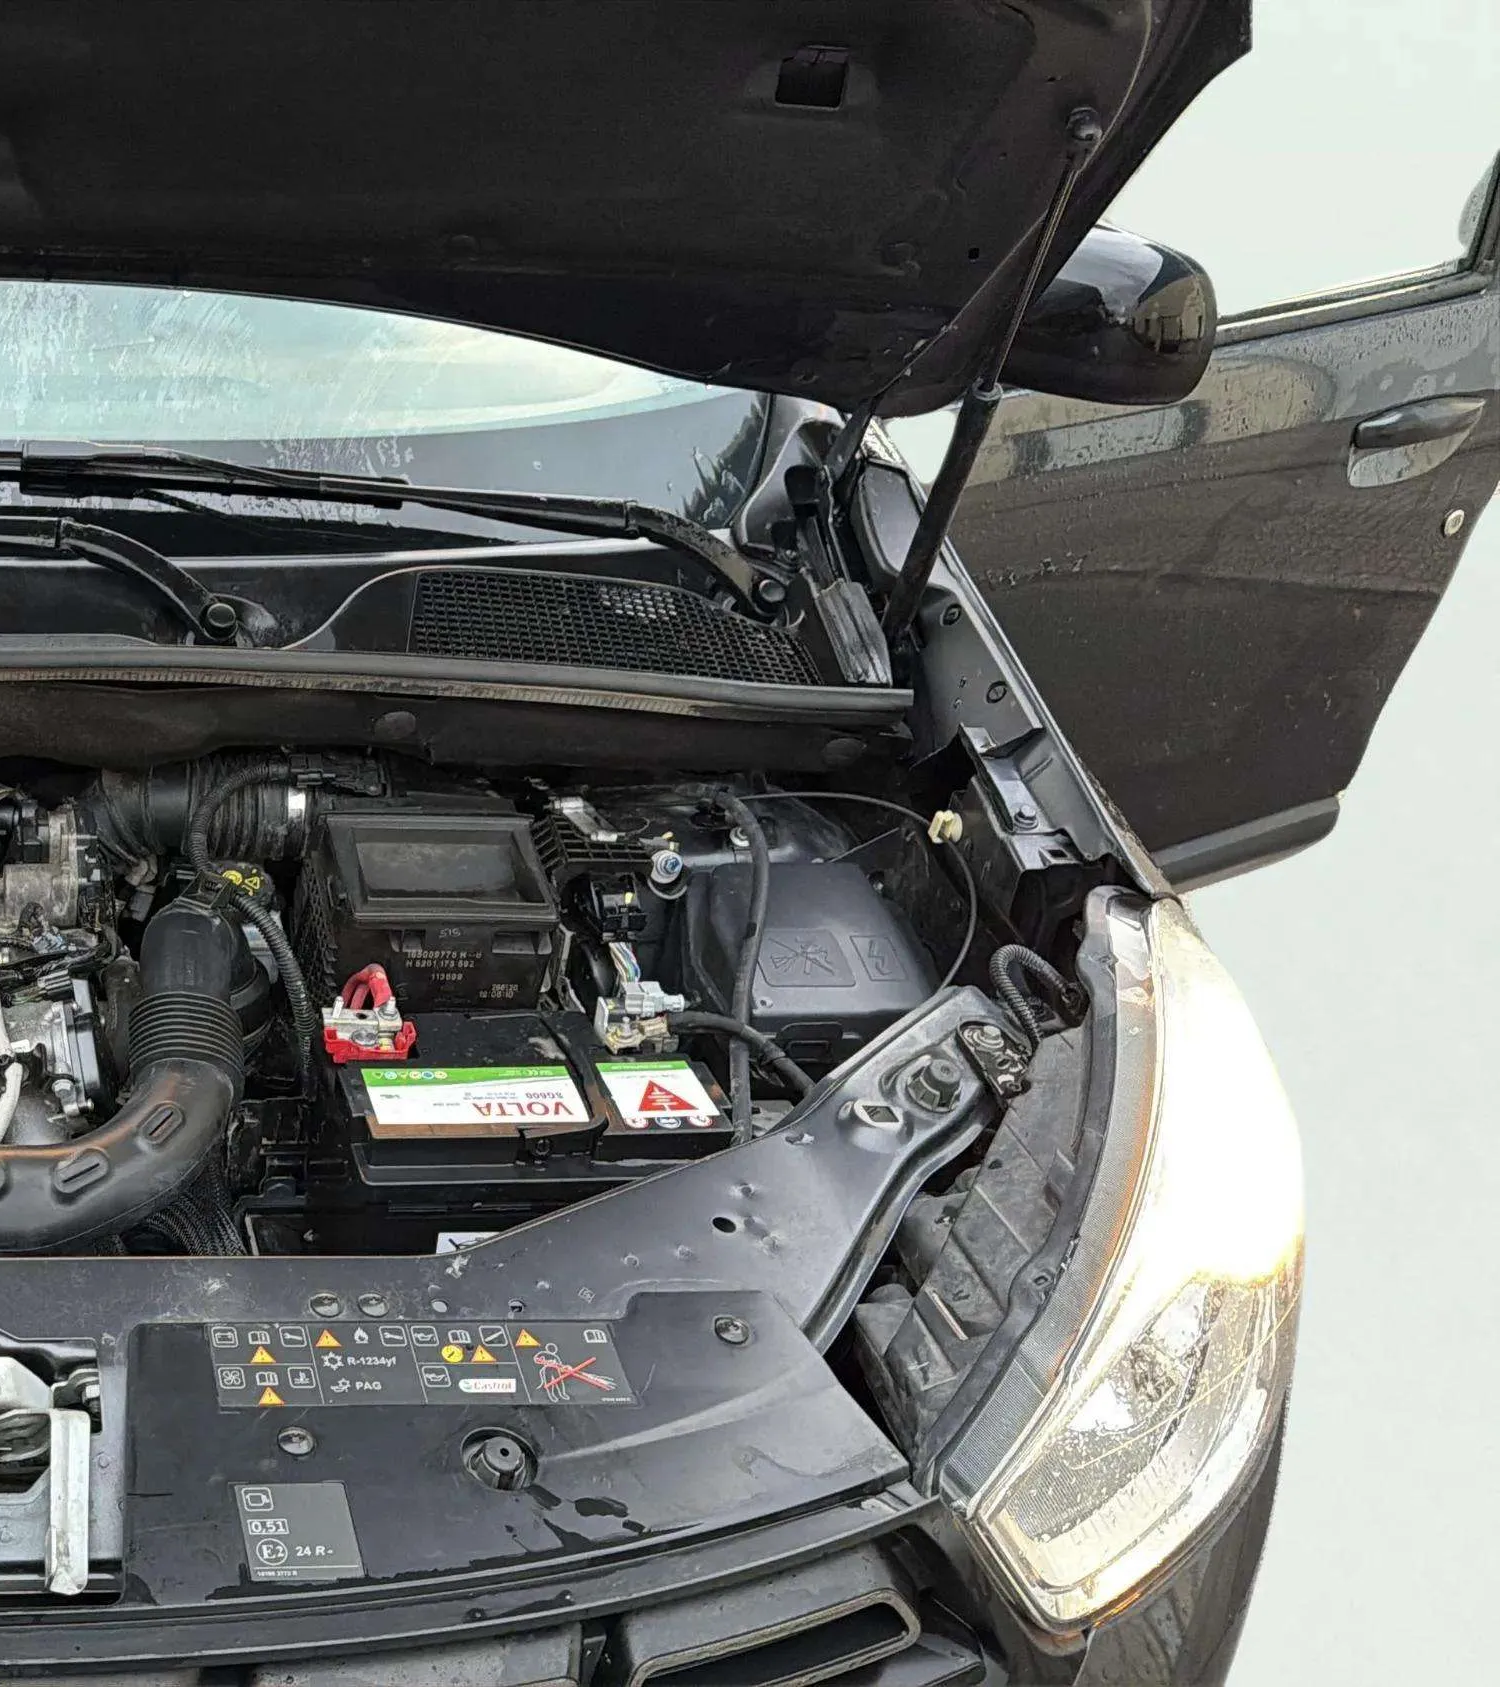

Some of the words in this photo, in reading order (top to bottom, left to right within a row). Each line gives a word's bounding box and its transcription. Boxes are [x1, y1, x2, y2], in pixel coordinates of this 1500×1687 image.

[472, 1101, 573, 1116] VOLTA
[347, 1356, 396, 1367] R-1234yf
[355, 1381, 382, 1390] PAG
[473, 1380, 512, 1391] Castrol
[251, 1520, 286, 1533] 0,51
[260, 1544, 285, 1559] E2
[295, 1545, 311, 1556] 24
